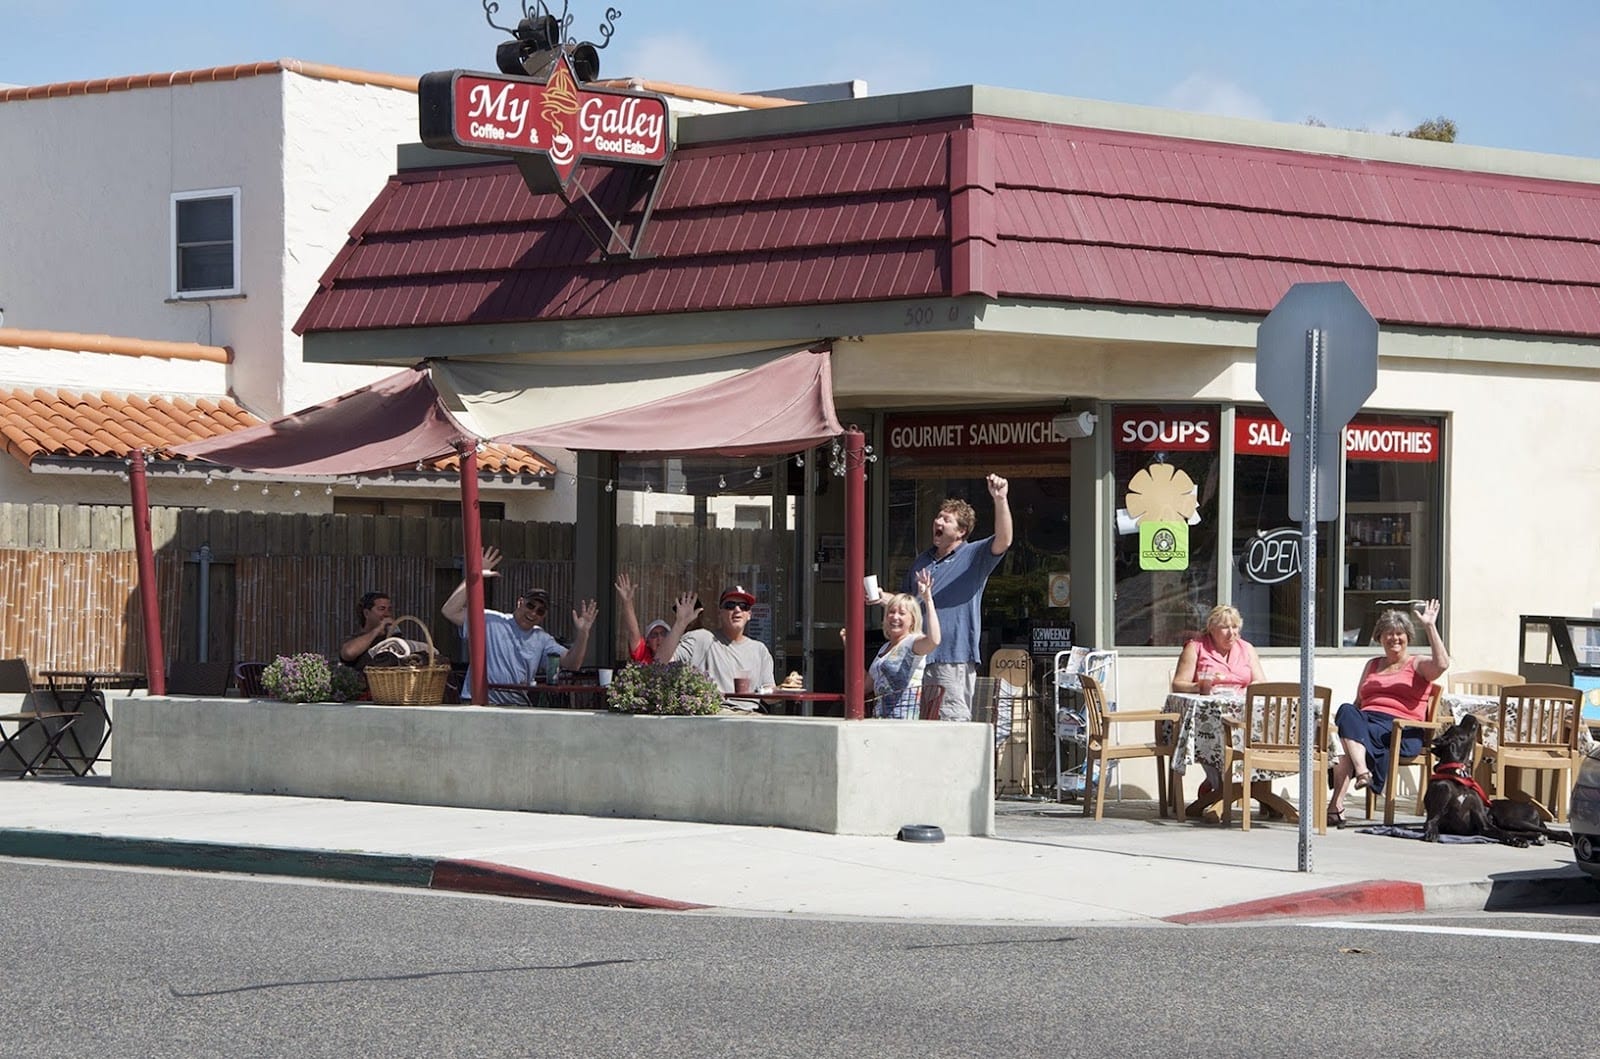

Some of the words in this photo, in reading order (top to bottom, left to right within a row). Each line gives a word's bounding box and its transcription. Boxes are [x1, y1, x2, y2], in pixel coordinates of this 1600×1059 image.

[468, 83, 530, 138] My
[579, 97, 664, 154] Galley
[470, 121, 505, 140] Coffee
[529, 127, 540, 144] &
[594, 137, 622, 153] Good
[624, 138, 646, 155] Eats
[903, 305, 934, 327] 500
[890, 425, 964, 448] GOURMET
[969, 421, 1068, 446] SANDWICHE
[1122, 420, 1210, 443] SOUPS
[1248, 422, 1291, 447] SALA
[1346, 429, 1432, 454] SMOOTHIES
[1249, 540, 1302, 573] OPEN
